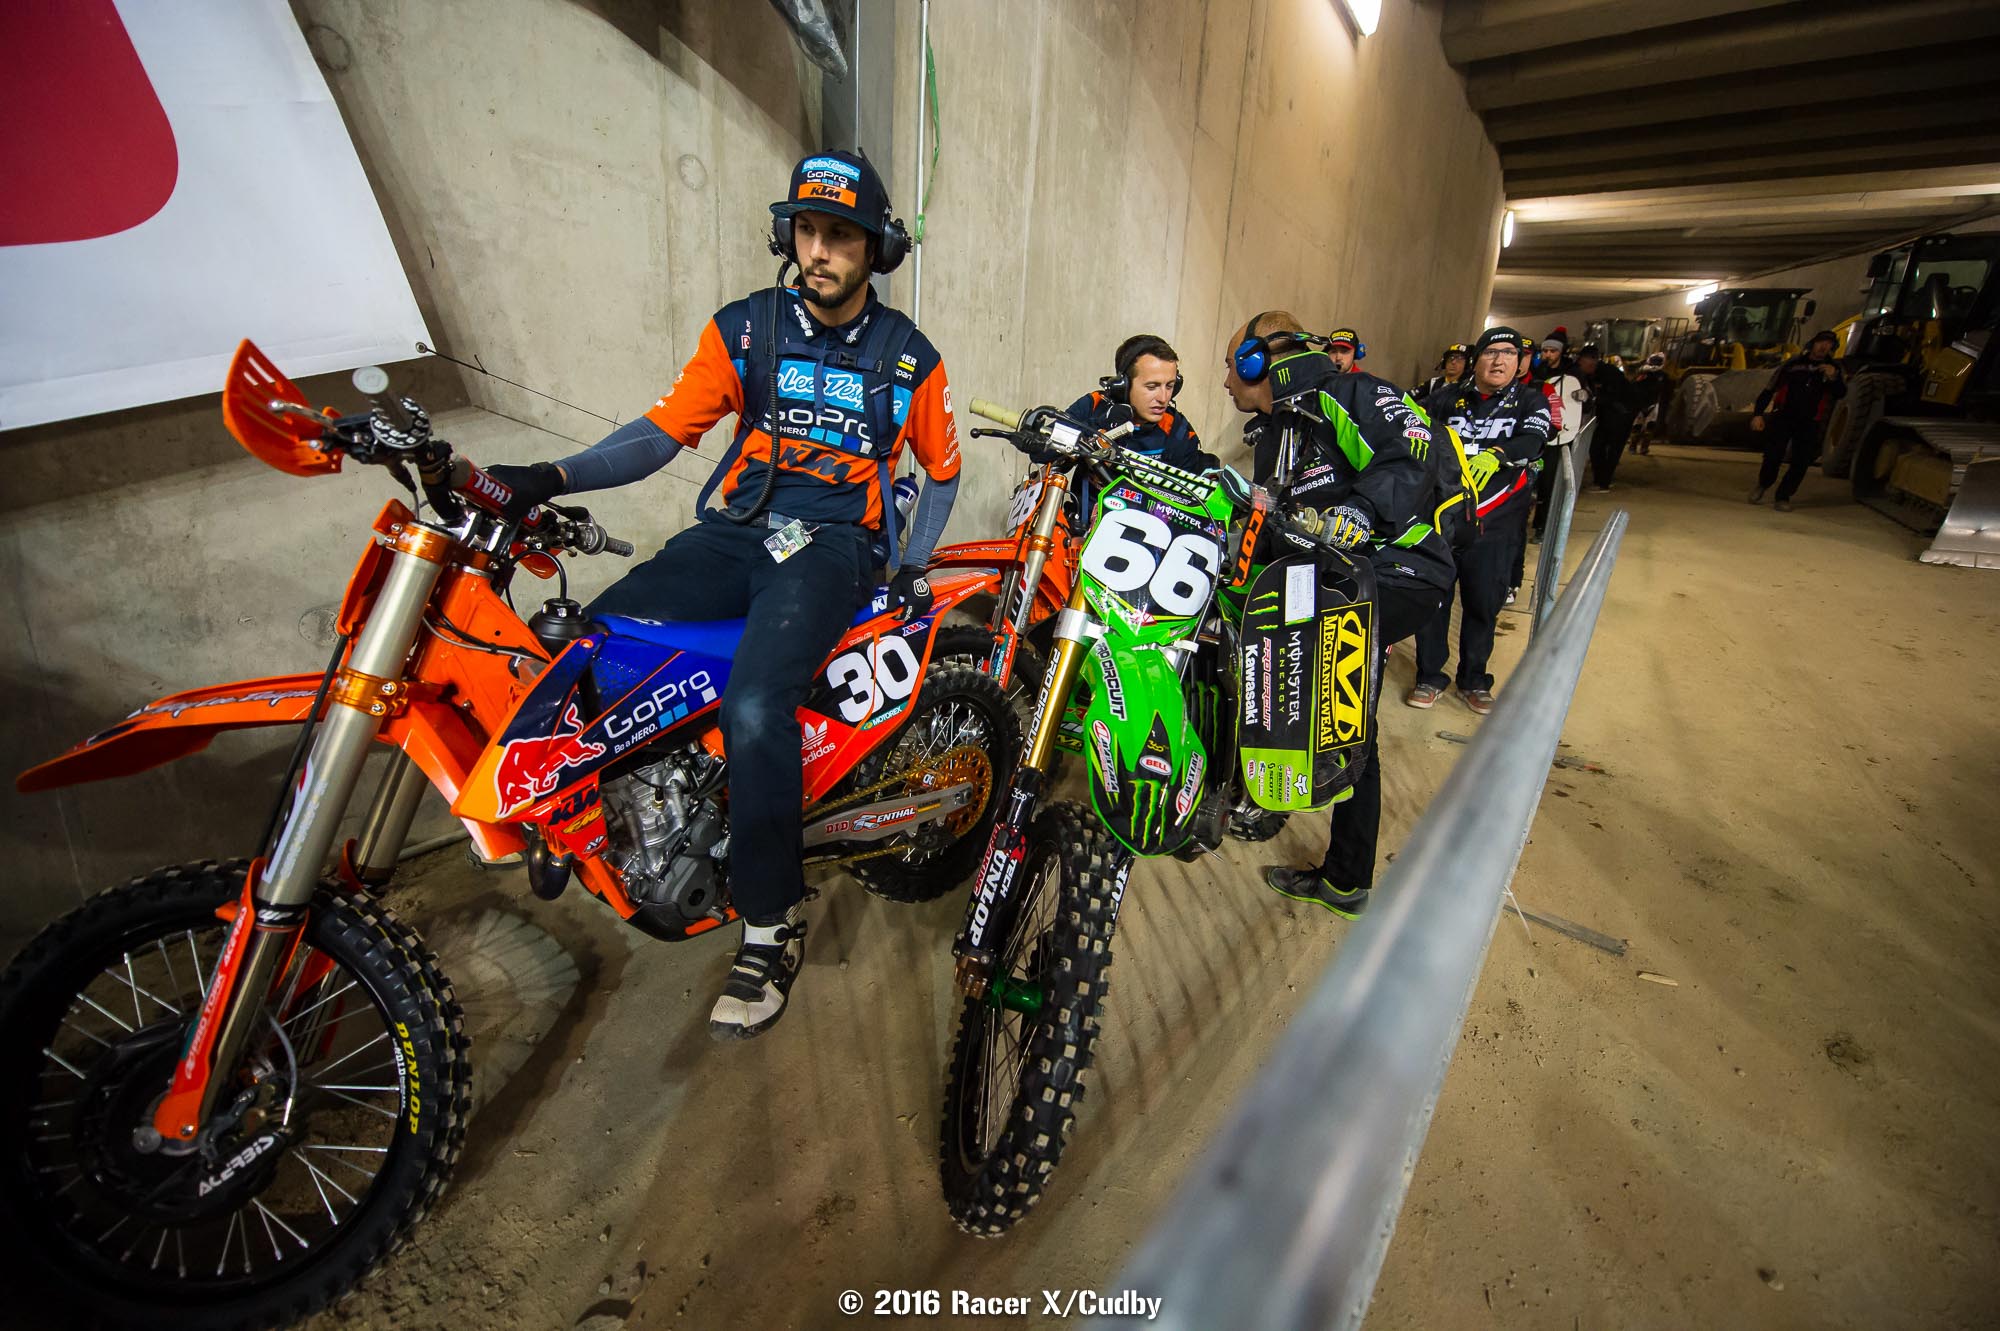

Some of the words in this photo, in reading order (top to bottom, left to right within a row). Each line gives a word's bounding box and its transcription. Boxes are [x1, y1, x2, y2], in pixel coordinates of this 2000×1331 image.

[807, 170, 847, 184] GoPro
[810, 185, 841, 199] KTM
[1408, 430, 1427, 439] BELL
[778, 443, 852, 483] KTM
[1112, 488, 1142, 503] AMA
[1116, 465, 1211, 501] RENTHA
[1290, 473, 1335, 496] Kawasaki
[1156, 503, 1202, 530] MONSTER
[1082, 508, 1220, 616] 66
[958, 581, 986, 596] DUNLOP
[903, 621, 928, 637] AMA
[1044, 647, 1061, 689] PRO
[1095, 642, 1111, 660] PRO
[1262, 636, 1272, 672] PRO
[1320, 614, 1339, 702] MECHANIX
[827, 635, 920, 722] 30
[1102, 659, 1126, 721] CIRCUIT
[1245, 644, 1258, 725] Kawasaki
[1287, 631, 1303, 726] MONSTER
[604, 670, 711, 739] GoPro
[872, 707, 903, 726] MOTOREX
[1262, 671, 1272, 732] CIRCUIT
[1024, 687, 1049, 761] CIRCUIT
[1320, 702, 1335, 747] WEAR
[614, 744, 625, 754] Be
[802, 742, 836, 766] adidas
[1101, 737, 1120, 793] MAXIMA
[1146, 758, 1168, 772] BELL
[1183, 751, 1200, 796] MAXIMA
[825, 820, 849, 835] DID
[851, 806, 916, 833] RENTHAL
[1001, 858, 1018, 898] TECH
[971, 849, 1008, 947] UNLOP
[395, 1021, 421, 1135] DUNLOP
